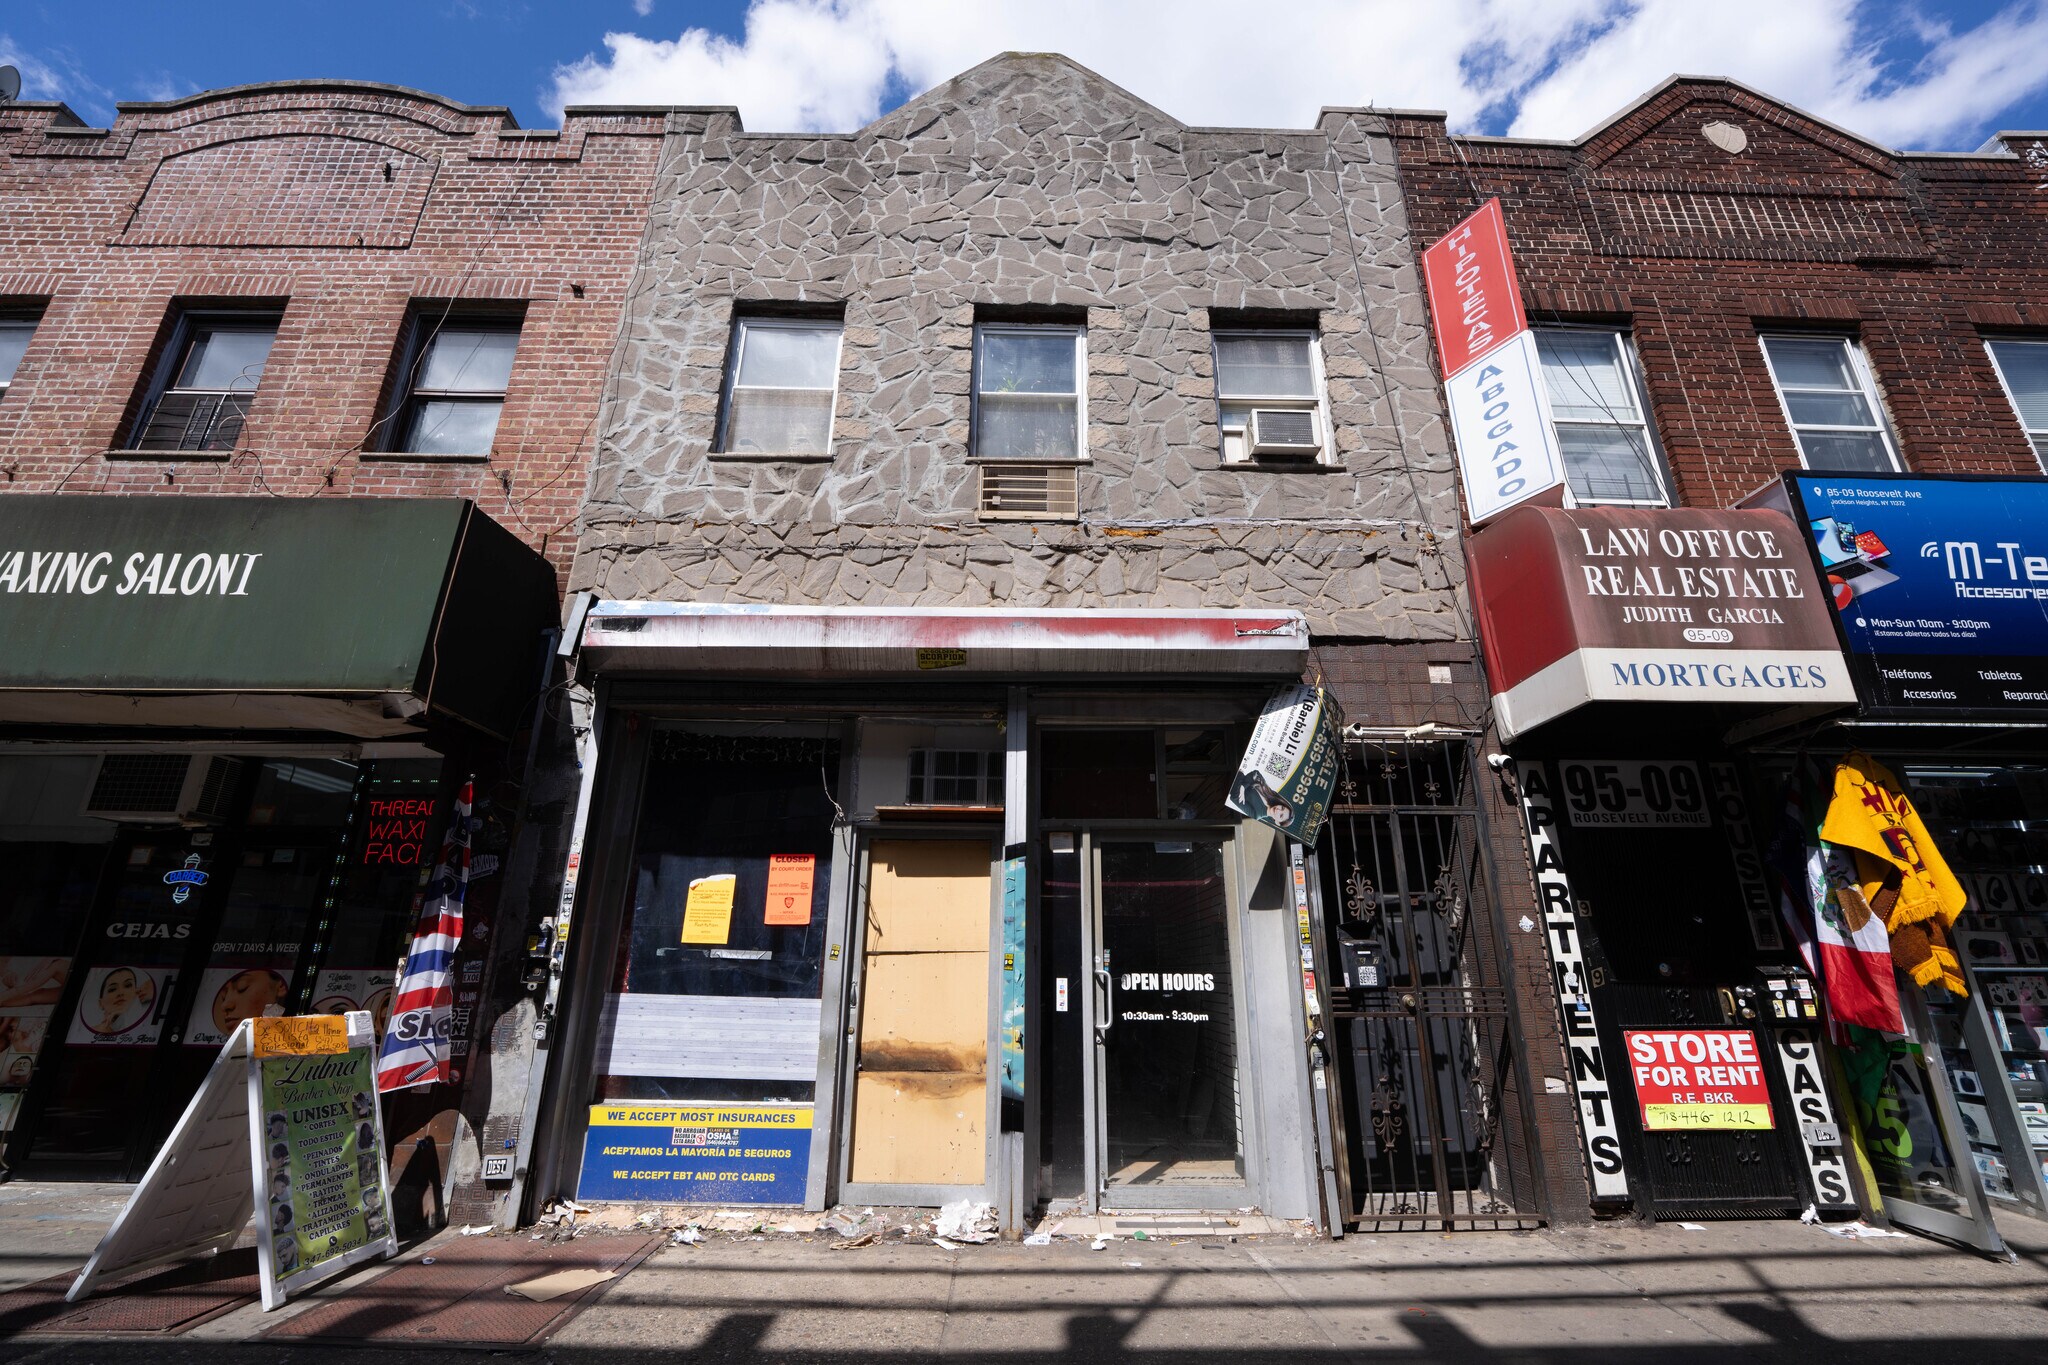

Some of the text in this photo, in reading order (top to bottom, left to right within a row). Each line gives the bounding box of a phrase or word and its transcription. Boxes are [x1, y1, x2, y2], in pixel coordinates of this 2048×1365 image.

[1448, 226, 1493, 355] HIPOTECAS
[1475, 364, 1526, 497] ABOGADO
[1856, 489, 1903, 498] Roosevelt
[1905, 490, 1922, 498] Ave
[1579, 528, 1783, 559] LAW OFFICE
[1581, 566, 1804, 598] REAL ESTATE
[1623, 607, 1784, 624] JUDITH GARCIA
[1870, 619, 1915, 628] Mon-Sun
[1917, 619, 1944, 628] 10am
[1952, 620, 1990, 630] 9:00pm
[1687, 630, 1730, 641] 95-09
[1610, 663, 1827, 688] MORTGAGES
[1882, 669, 2023, 680] Teléfonos Tabletas
[1903, 690, 1957, 699] Accesorios
[1565, 766, 1703, 812] 95-09
[1574, 812, 1707, 823] ROOSEVELT AVENUE
[169, 871, 206, 884] BARBER
[106, 923, 191, 938] CEJAS
[212, 943, 300, 953] OPEN 7 DAYS A WEEK
[1523, 769, 1623, 1175] APARTMENTS
[1121, 973, 1215, 991] OPEN HOURS
[1122, 1011, 1164, 1020] 10:30am
[1630, 1034, 1758, 1064] STORE
[1636, 1066, 1761, 1087] FOR RENT
[282, 1082, 353, 1104] Barber Shop
[1672, 1093, 1739, 1104] R.E. BKR.
[293, 1102, 349, 1124] UNISEX
[607, 1111, 796, 1123] WE ACCEPT MOST INSURANCES
[309, 1119, 336, 1130] CORTES
[298, 1131, 344, 1148] TODO ESTILO
[306, 1146, 343, 1160] PEINADOS
[603, 1146, 791, 1158] ACEPTAMOS LA MAYORÍA DE SEGUROS
[314, 1156, 340, 1168] TINTES
[305, 1163, 349, 1180] ONDULADOS
[613, 1171, 775, 1182] WE ACCEPT EBT AND OTC CARDS
[301, 1171, 353, 1191] PERMANENTES
[312, 1183, 344, 1199] RAYITOS
[313, 1192, 346, 1208] TRENZAS
[312, 1202, 348, 1219] ALIZADOS
[302, 1207, 360, 1233] TRATAMIENTOS
[309, 1220, 351, 1240] CAPILARES
